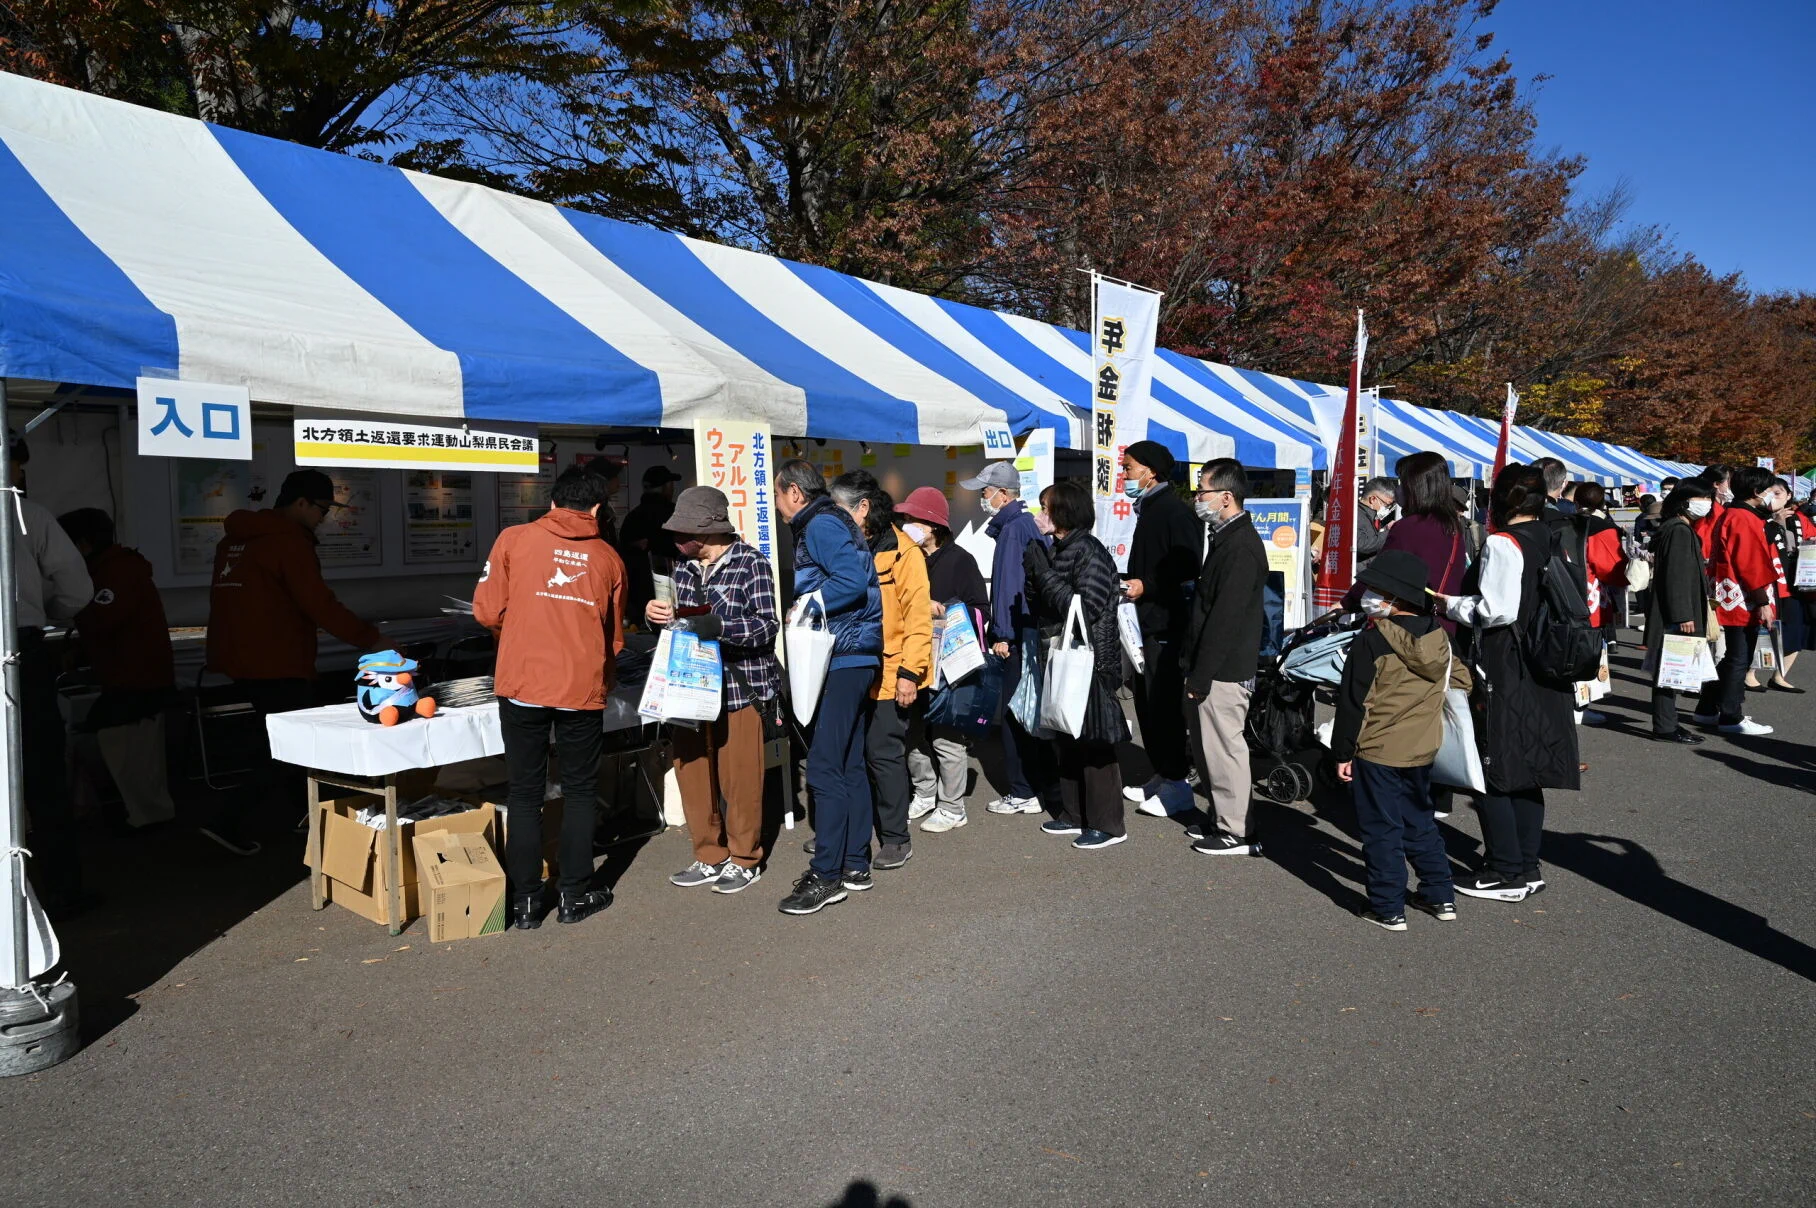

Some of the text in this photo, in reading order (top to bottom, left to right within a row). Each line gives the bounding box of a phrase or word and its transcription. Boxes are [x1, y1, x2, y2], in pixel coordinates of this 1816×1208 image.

[149, 396, 240, 441] 入口
[302, 426, 534, 452] 北方領土返還要求運動山梨県民会議
[984, 429, 1012, 449] 出口
[728, 443, 748, 542] アルコー
